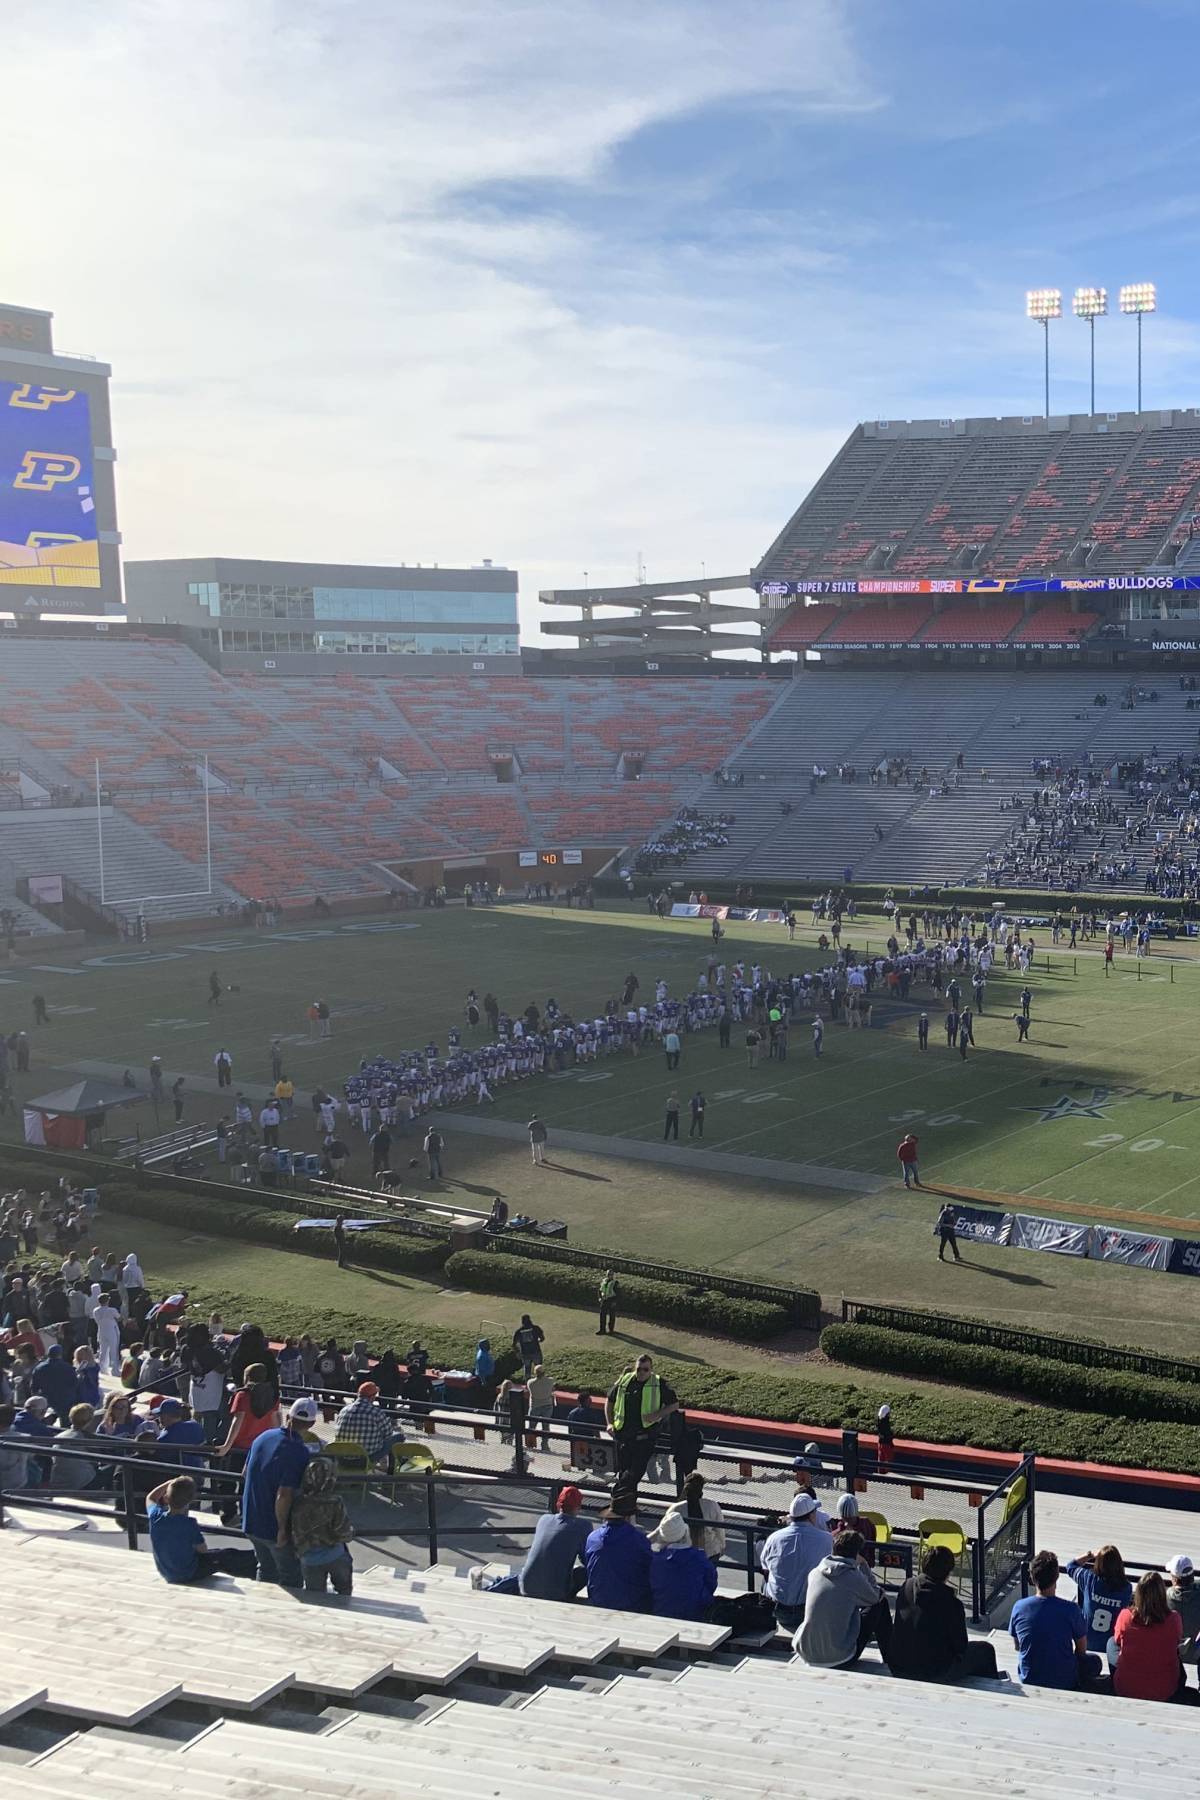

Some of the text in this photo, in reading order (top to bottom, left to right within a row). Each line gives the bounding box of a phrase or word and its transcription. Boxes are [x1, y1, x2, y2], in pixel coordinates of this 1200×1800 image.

[797, 582, 822, 593] SUPER
[825, 582, 830, 593] 7
[832, 582, 856, 593] STATE
[858, 581, 920, 592] CHAMPIONSHIPS
[930, 581, 957, 592] SUPER
[1060, 576, 1174, 590] PIEDMONT BULLDOGS
[1152, 641, 1196, 650] NATIONAL
[542, 854, 557, 865] 40
[1083, 1133, 1165, 1152] 20
[953, 1216, 996, 1236] Encore
[1092, 1593, 1122, 1608] WHITE
[1092, 1608, 1112, 1632] 8
